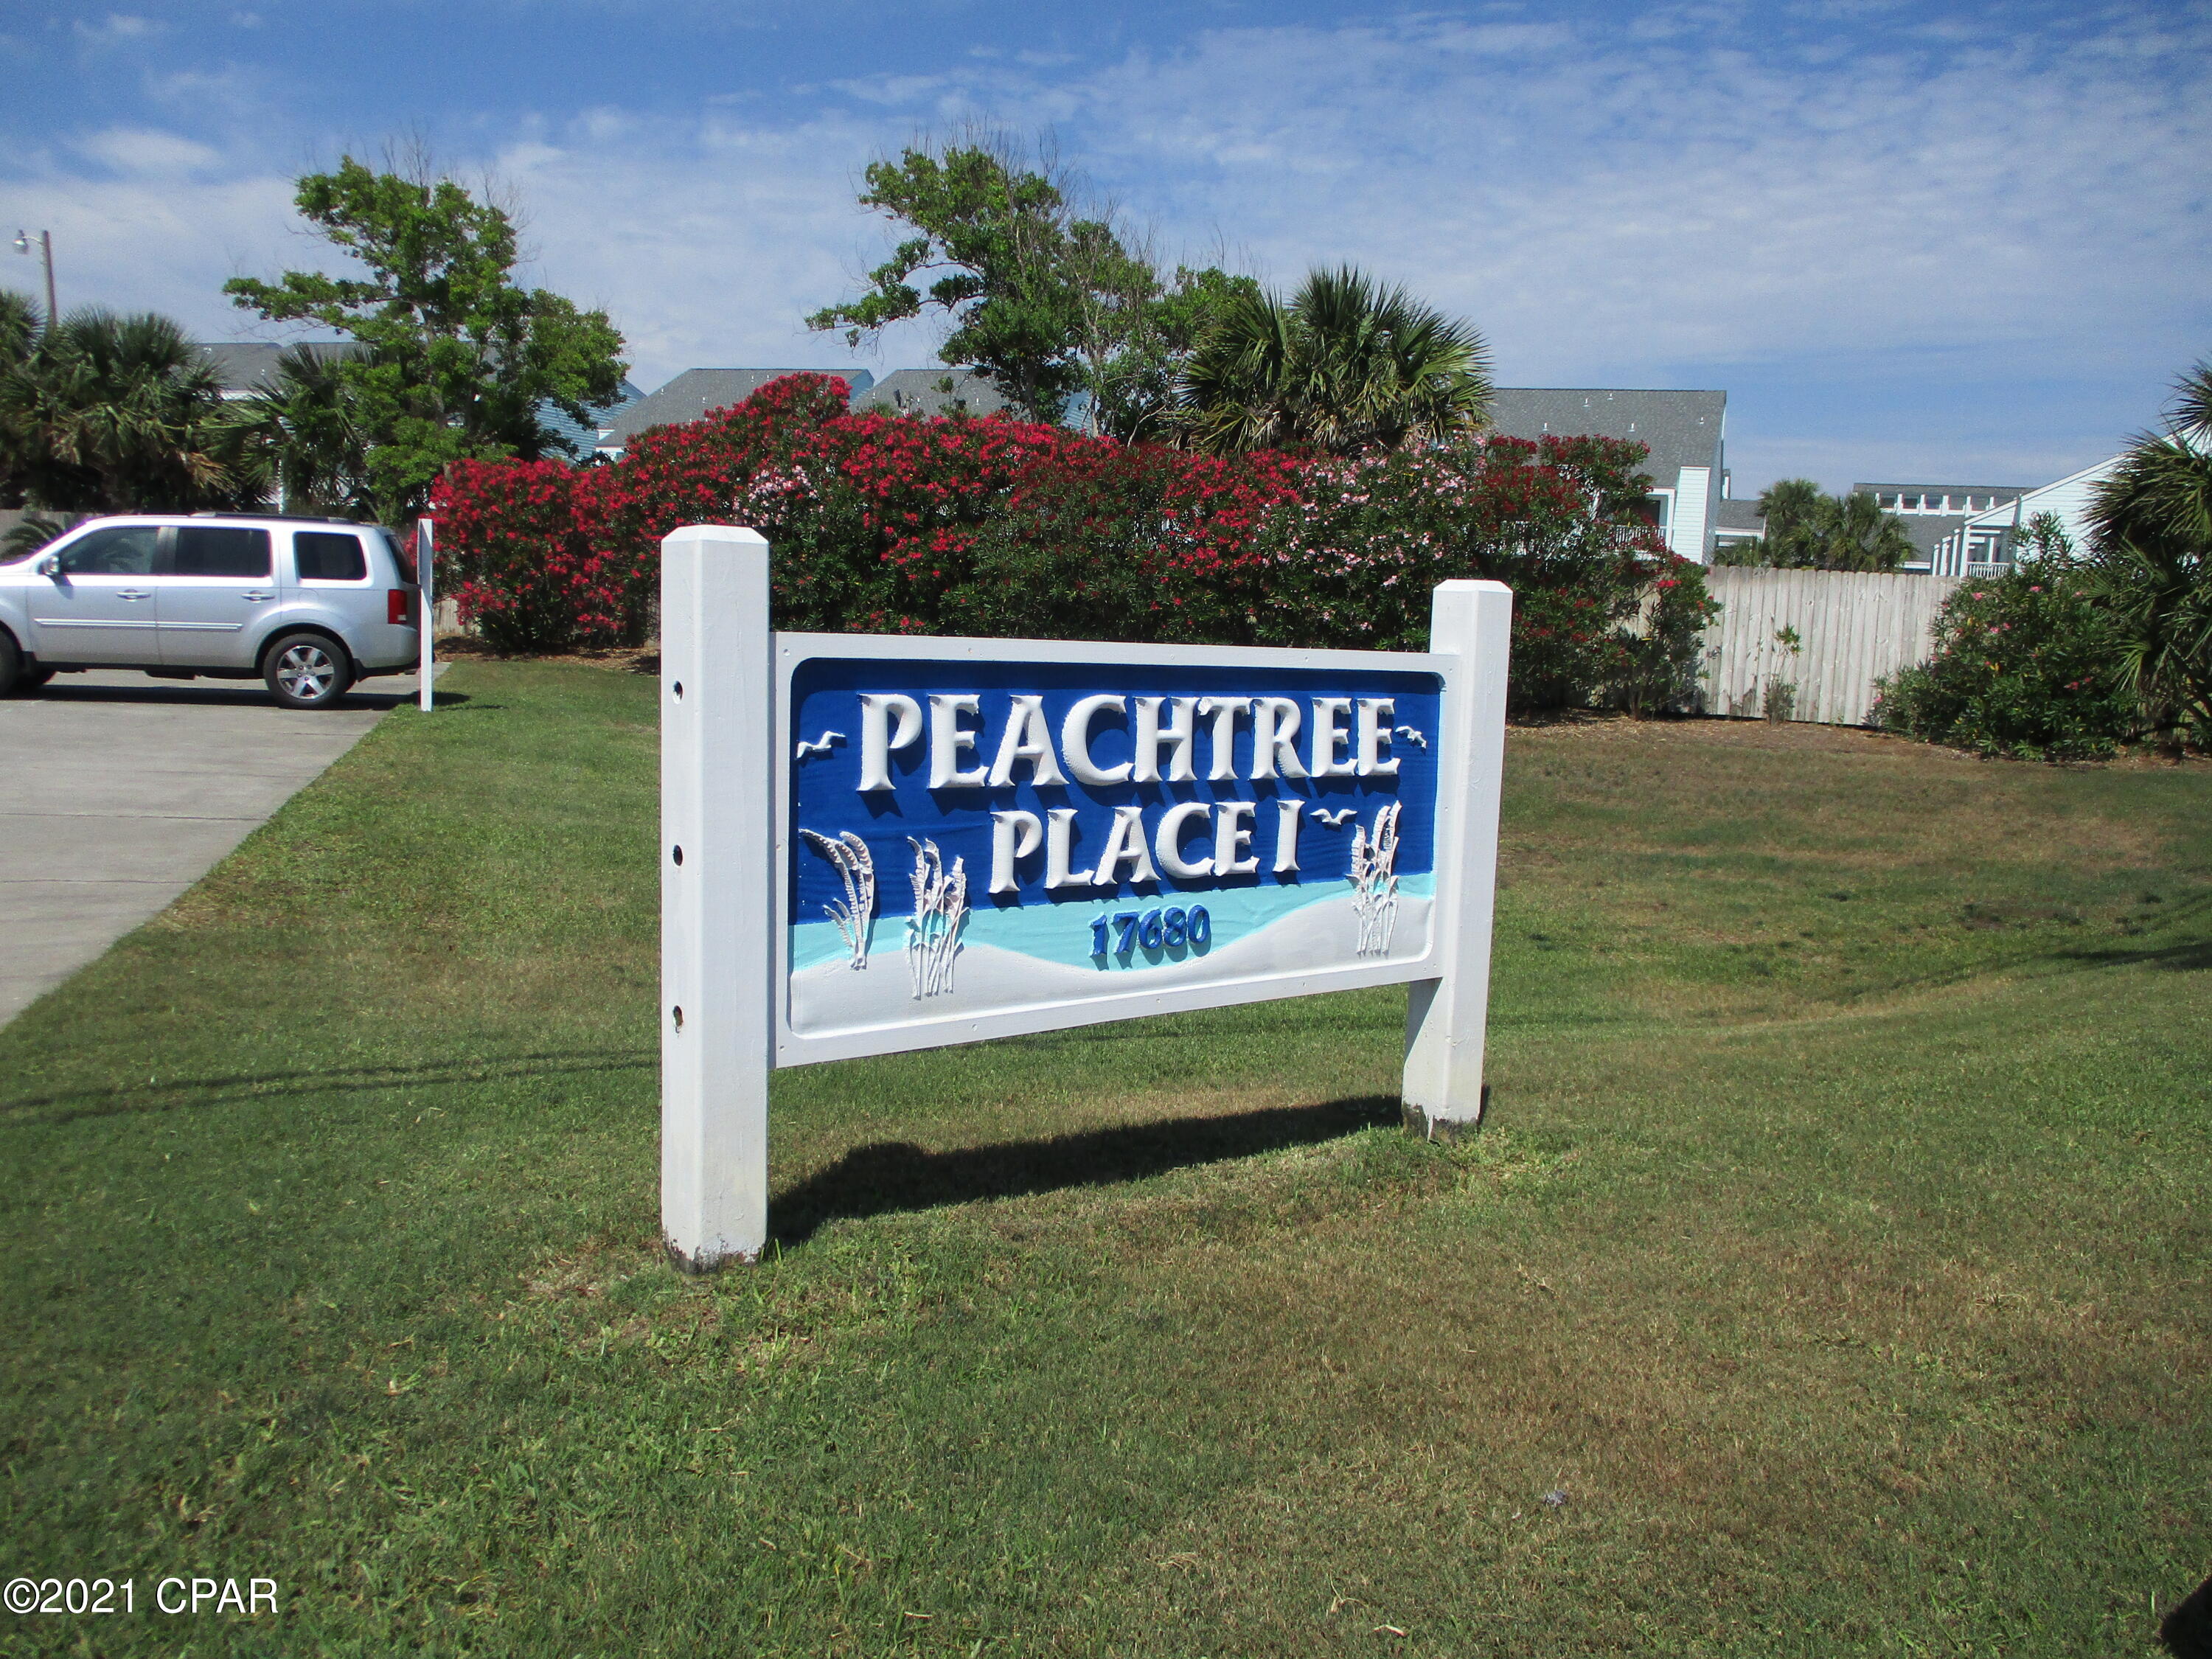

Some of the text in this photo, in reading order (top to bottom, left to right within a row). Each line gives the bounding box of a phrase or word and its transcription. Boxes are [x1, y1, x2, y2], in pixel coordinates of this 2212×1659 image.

[857, 693, 1401, 791] PEACHTREE
[989, 799, 1304, 894] PLACE I
[1089, 903, 1211, 958] 17680
